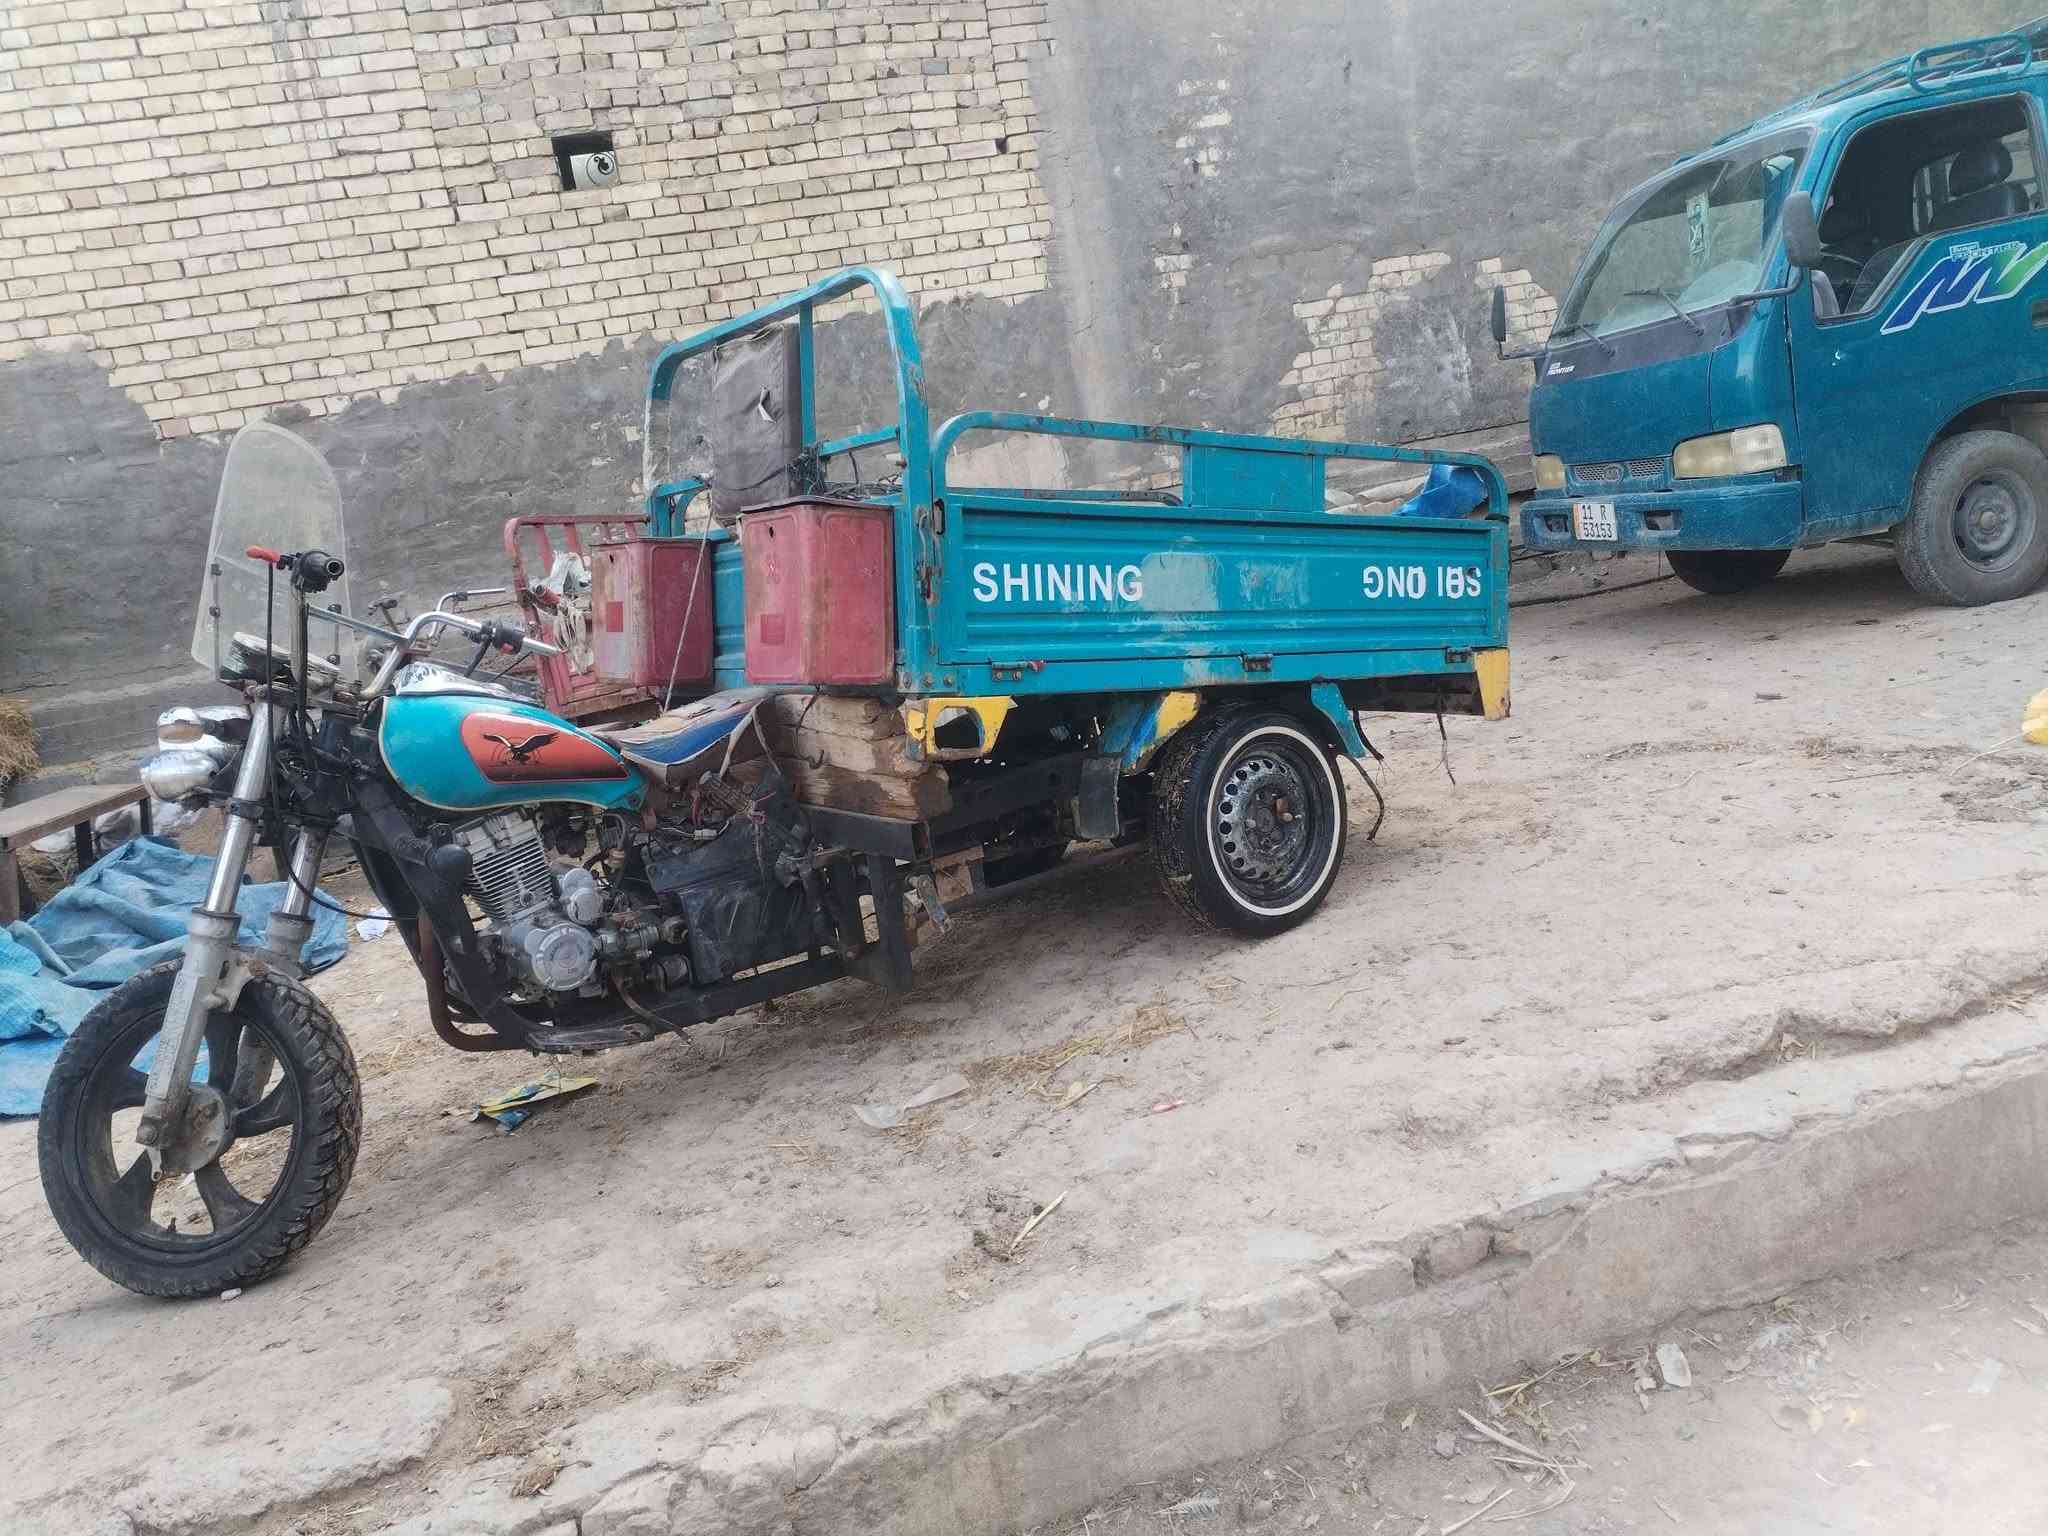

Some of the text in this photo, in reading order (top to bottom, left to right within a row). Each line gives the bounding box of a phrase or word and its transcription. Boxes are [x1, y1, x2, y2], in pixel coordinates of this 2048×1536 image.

[1582, 504, 1607, 520] 11 R
[1583, 522, 1612, 538] 53153
[972, 562, 1144, 602] SHINING
